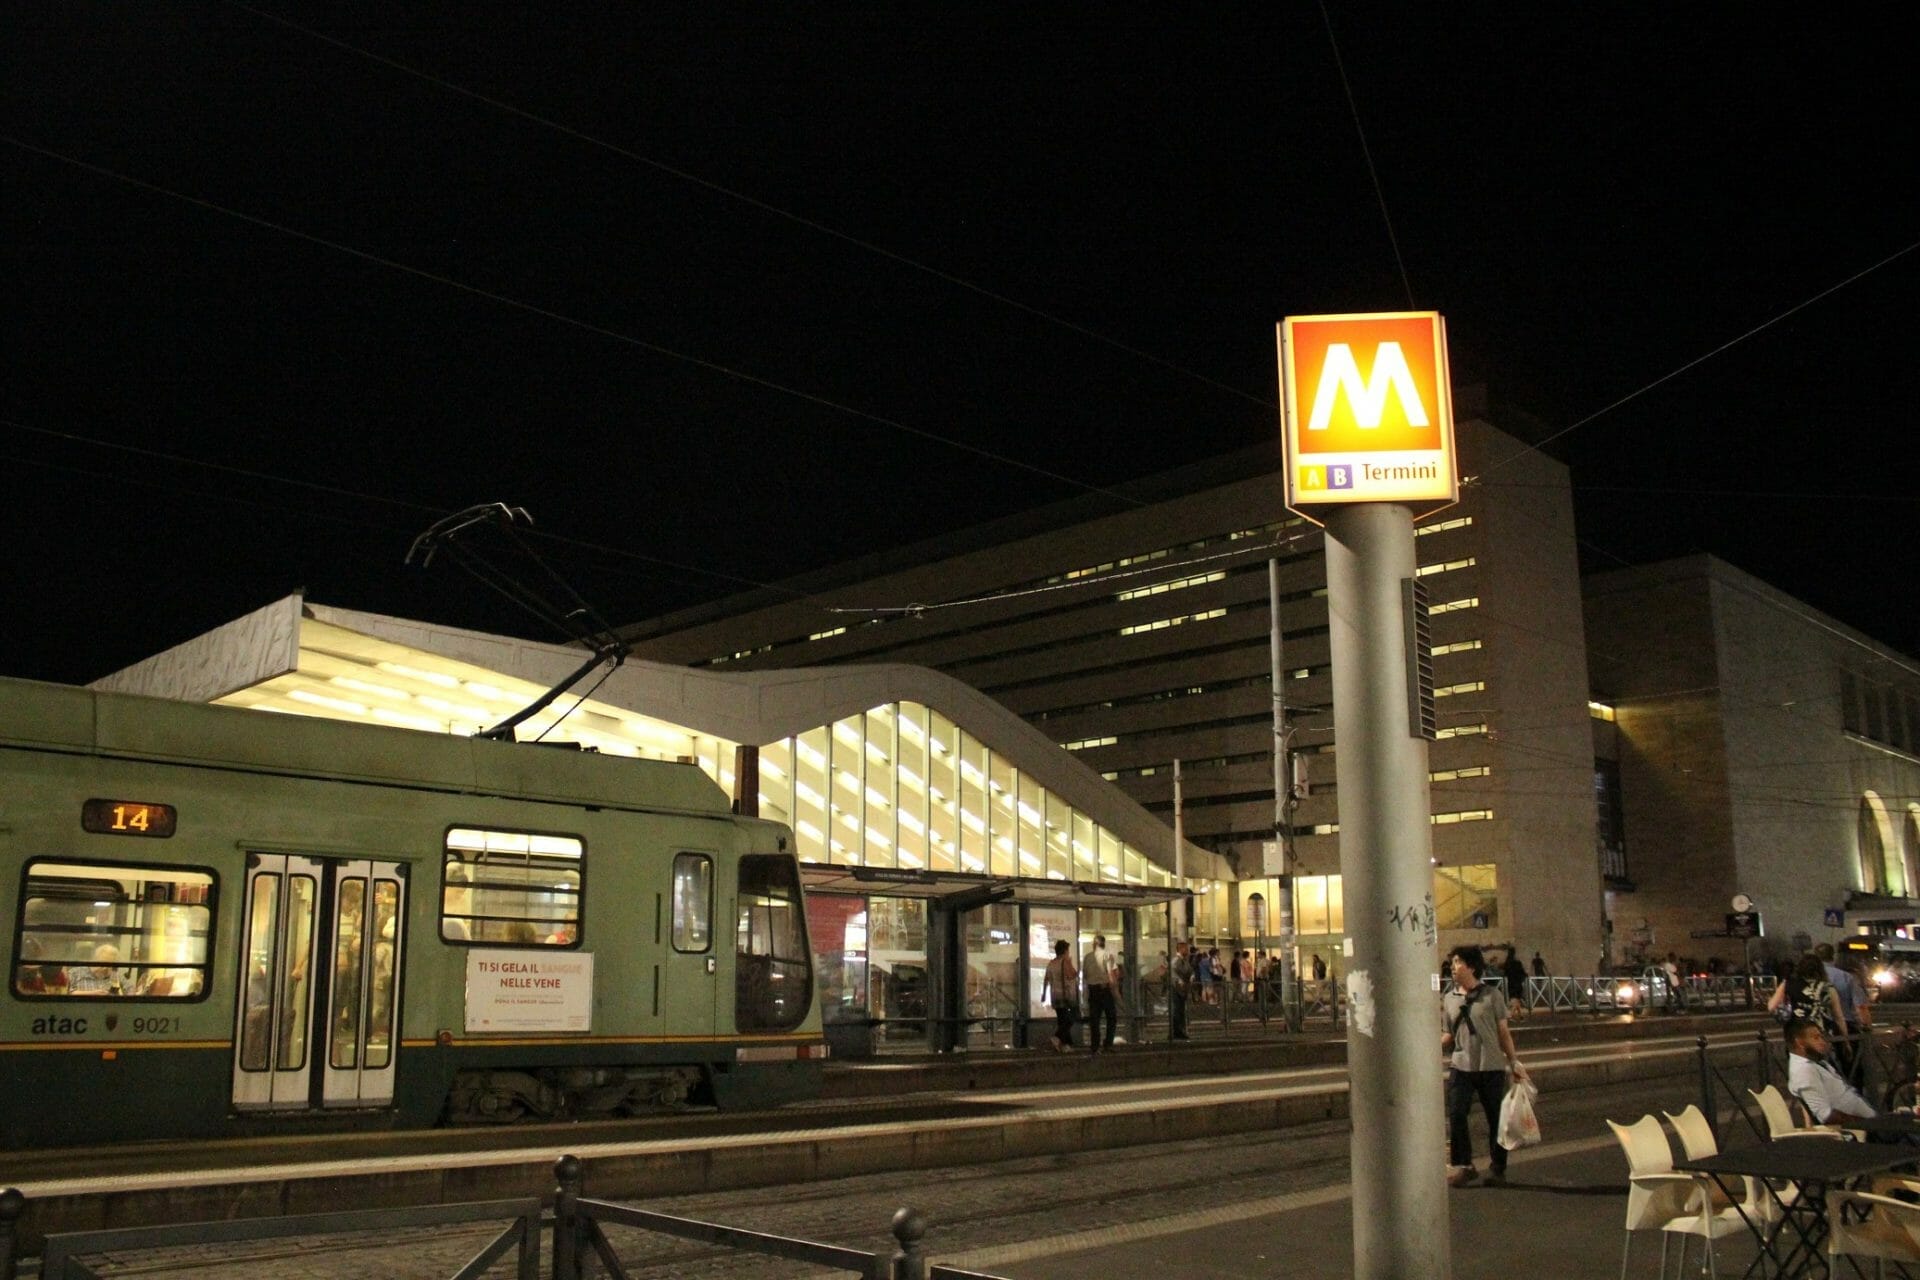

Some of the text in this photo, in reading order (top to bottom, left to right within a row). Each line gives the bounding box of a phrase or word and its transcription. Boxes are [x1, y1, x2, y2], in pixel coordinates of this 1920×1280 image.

[1308, 341, 1430, 430] M
[1306, 461, 1437, 487] A B Termini
[111, 806, 149, 831] 14
[478, 962, 488, 972] TI
[490, 962, 499, 973] SI
[501, 962, 528, 973] GELA
[530, 963, 539, 973] IL
[500, 978, 561, 988] NELLE VENE
[32, 1014, 180, 1034] atac 9021
